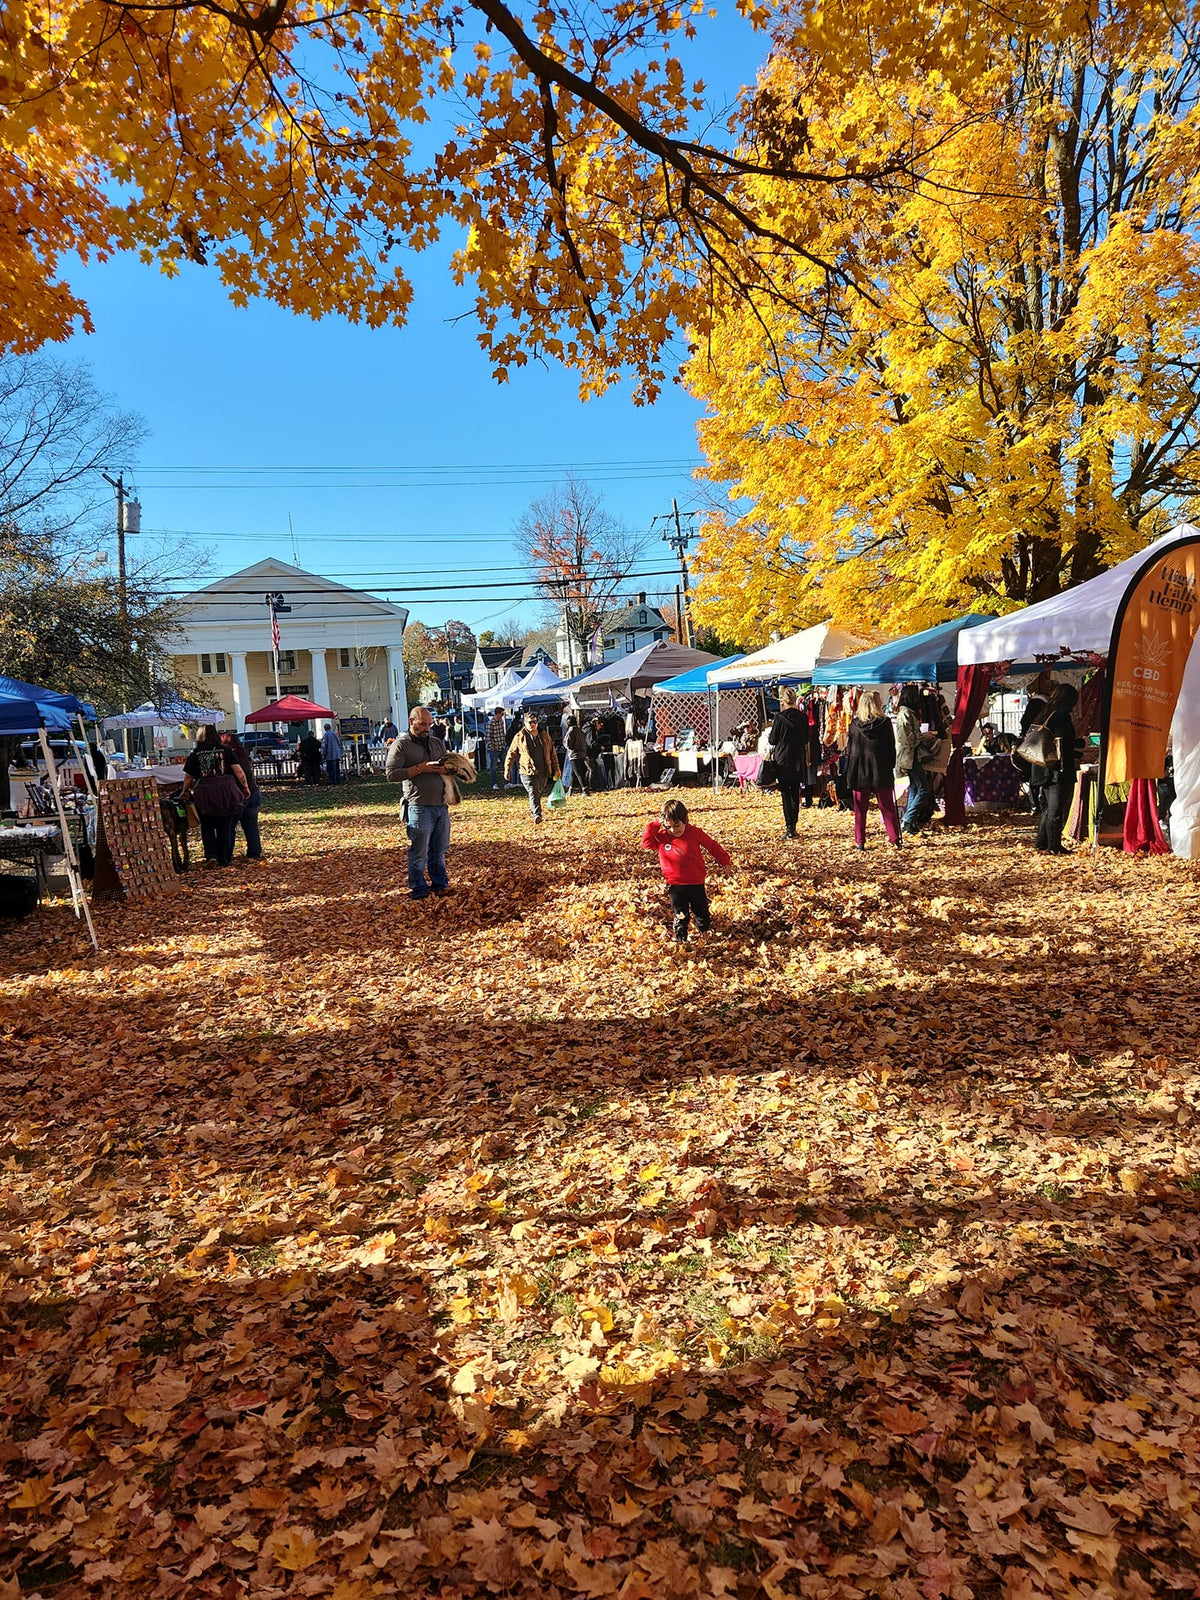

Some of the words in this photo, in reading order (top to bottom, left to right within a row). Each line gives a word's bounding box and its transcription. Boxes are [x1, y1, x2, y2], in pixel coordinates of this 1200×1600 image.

[1161, 566, 1197, 588] High
[1149, 590, 1193, 615] Hemp
[1163, 583, 1198, 603] Falls
[1133, 666, 1160, 681] CBD
[1132, 683, 1153, 693] YOUR
